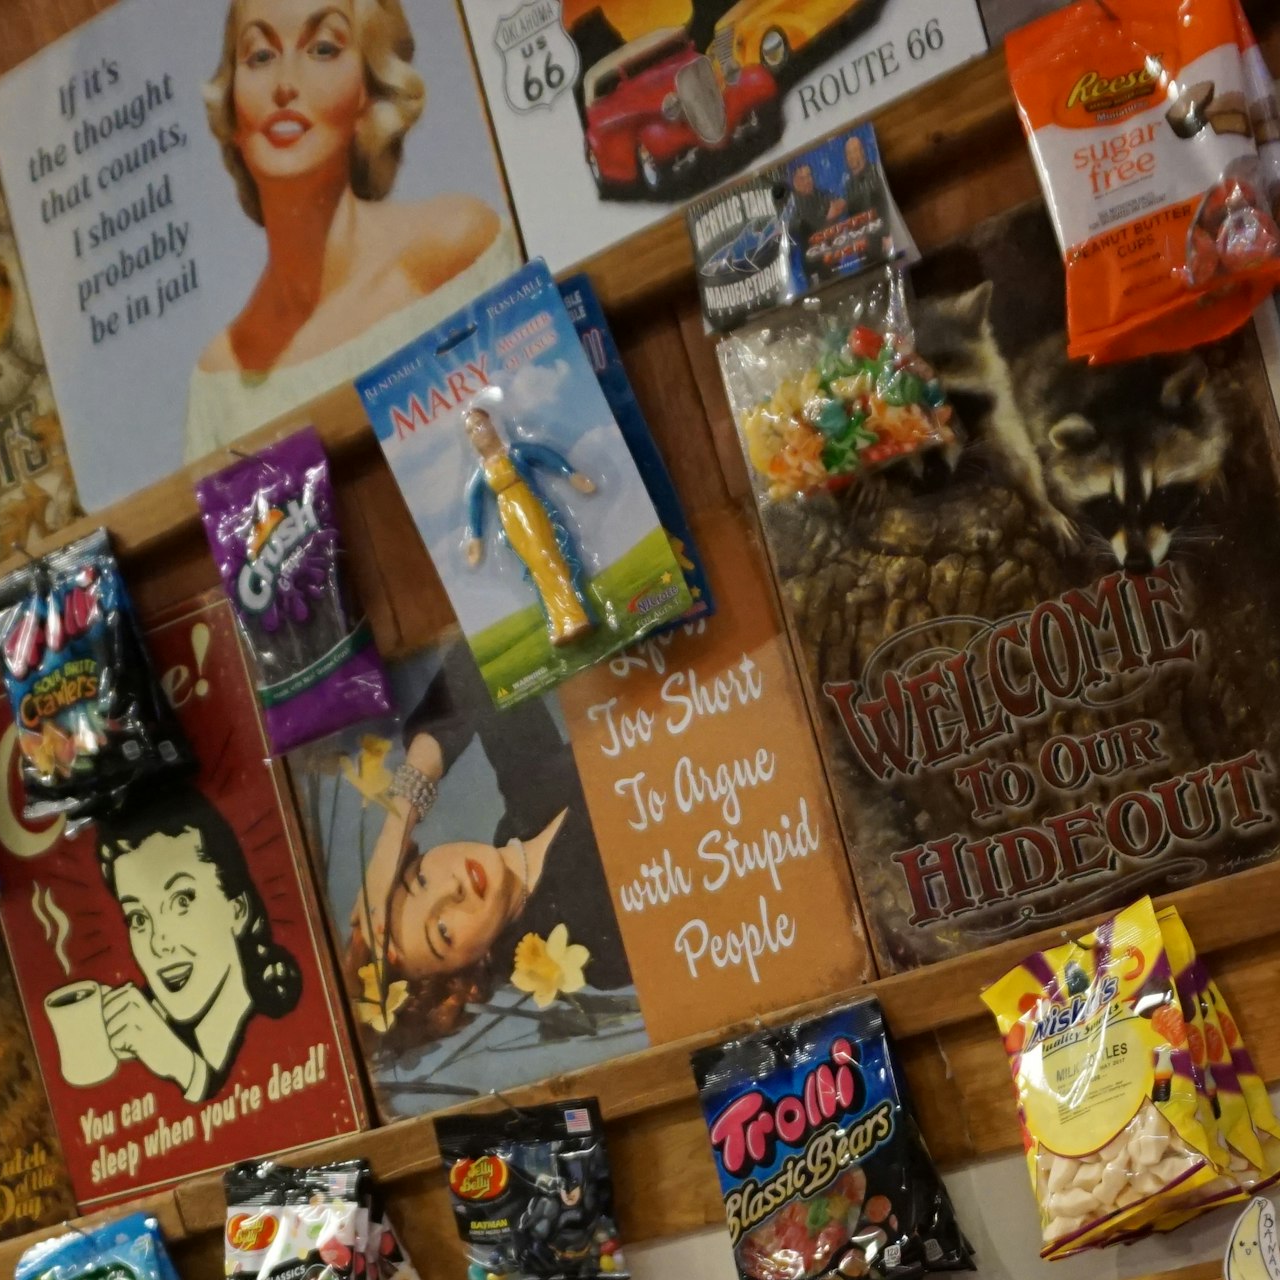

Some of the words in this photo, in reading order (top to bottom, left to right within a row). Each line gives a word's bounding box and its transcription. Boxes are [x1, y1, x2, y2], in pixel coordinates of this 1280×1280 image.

[500, 4, 556, 46] OKLAHOMA
[796, 40, 901, 121] ROUTE
[905, 17, 947, 60] 66
[59, 77, 83, 116] If
[83, 55, 120, 101] it's
[523, 53, 566, 102] 66
[27, 139, 67, 183] the
[70, 73, 175, 158] thought
[39, 176, 92, 225] that
[95, 119, 189, 193] counts,
[1073, 122, 1159, 173] sugar
[72, 224, 85, 259] I
[87, 173, 174, 251] should
[1088, 150, 1156, 196] free
[76, 219, 191, 313] probably
[695, 194, 744, 250] ACRYLIC
[1116, 232, 1156, 260] CUPS
[1133, 206, 1193, 241] BUTTER
[89, 306, 120, 347] be
[124, 291, 152, 328] in
[150, 260, 200, 327] jail
[364, 357, 423, 402] BENDABLE
[485, 274, 545, 320] POSEABLE
[389, 353, 493, 441] MARY
[19, 672, 99, 729] Crawlers
[587, 696, 656, 758] Too
[661, 652, 763, 736] Short
[823, 561, 1197, 781] WELCOME
[614, 771, 667, 831] To
[674, 747, 776, 827] Argue
[955, 757, 1035, 822] TO
[1038, 719, 1168, 792] OUR
[620, 848, 692, 913] with
[697, 797, 820, 892] Stupid
[891, 750, 1273, 927] HIDEOUT
[674, 894, 797, 984] People
[79, 1105, 117, 1146] You
[120, 1093, 156, 1131] can
[90, 1139, 141, 1185] sleep
[142, 1117, 197, 1160] when
[199, 1085, 262, 1142] you're
[267, 1042, 327, 1100] dead!
[710, 1036, 855, 1173] Trolli
[802, 1104, 891, 1196] Bears
[470, 1217, 509, 1230] BATMAN
